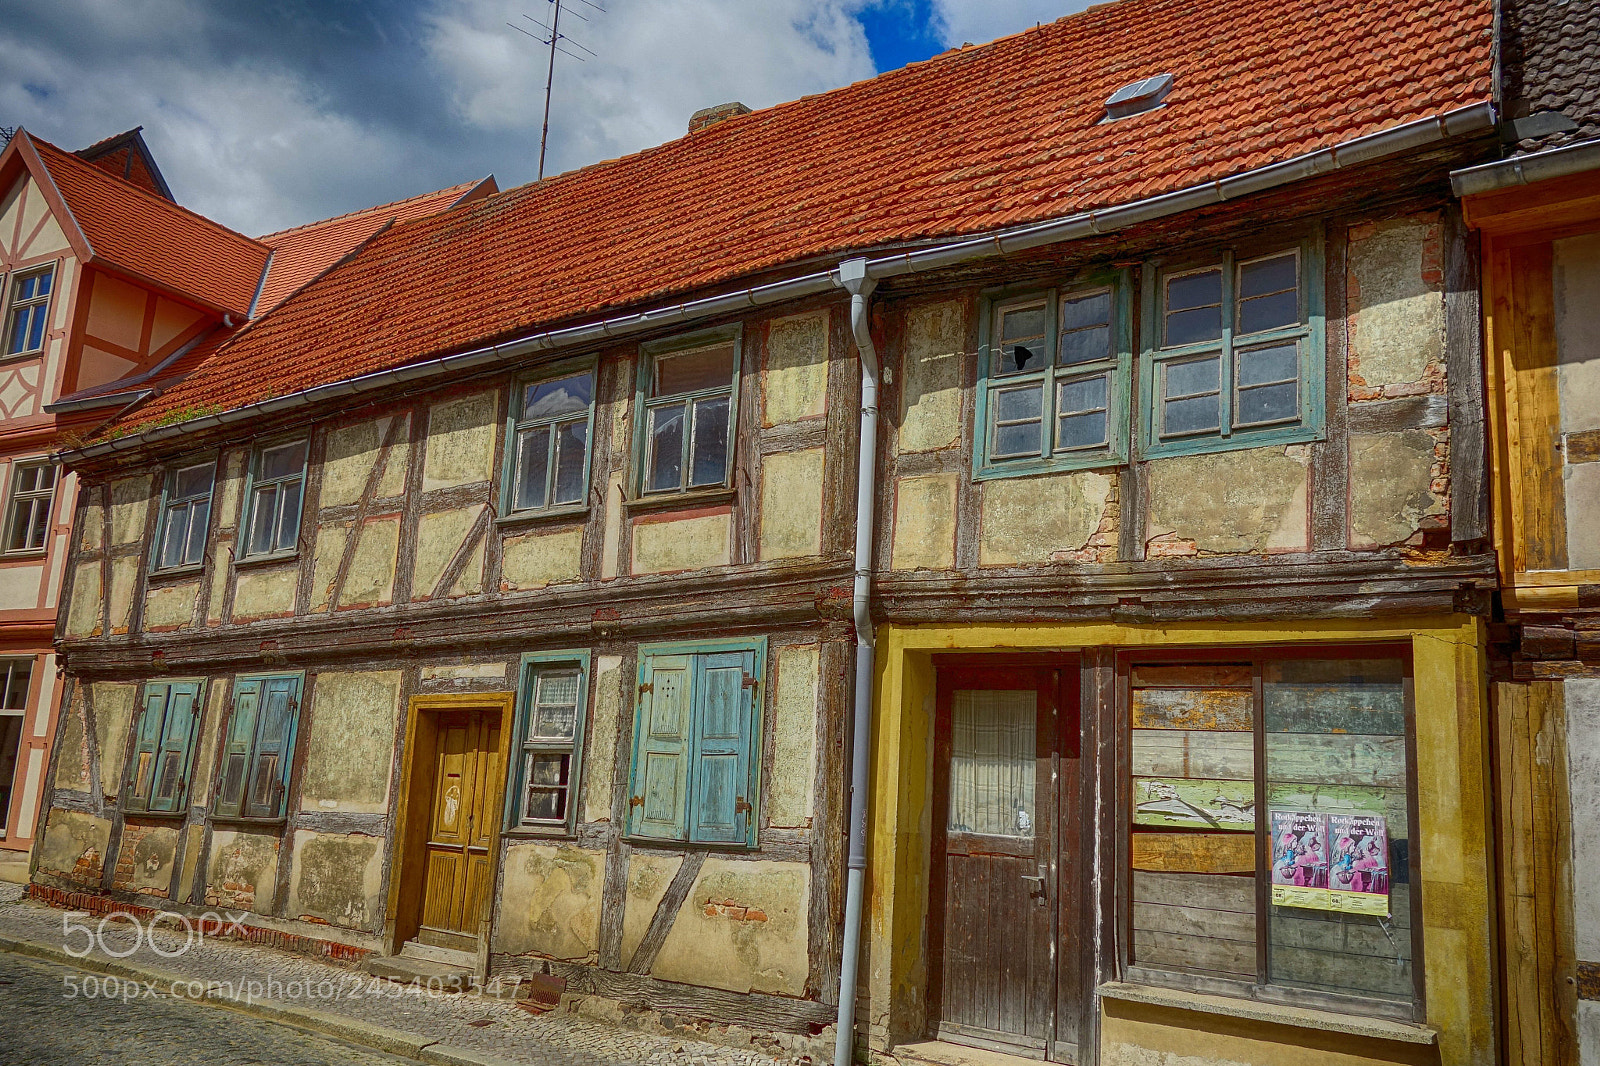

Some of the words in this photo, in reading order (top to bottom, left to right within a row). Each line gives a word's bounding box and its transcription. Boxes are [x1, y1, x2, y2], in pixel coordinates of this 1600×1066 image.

[1275, 813, 1321, 822] Rotkäppchen
[1331, 816, 1380, 826] Rotkäppchen
[1364, 828, 1385, 836] Wolf
